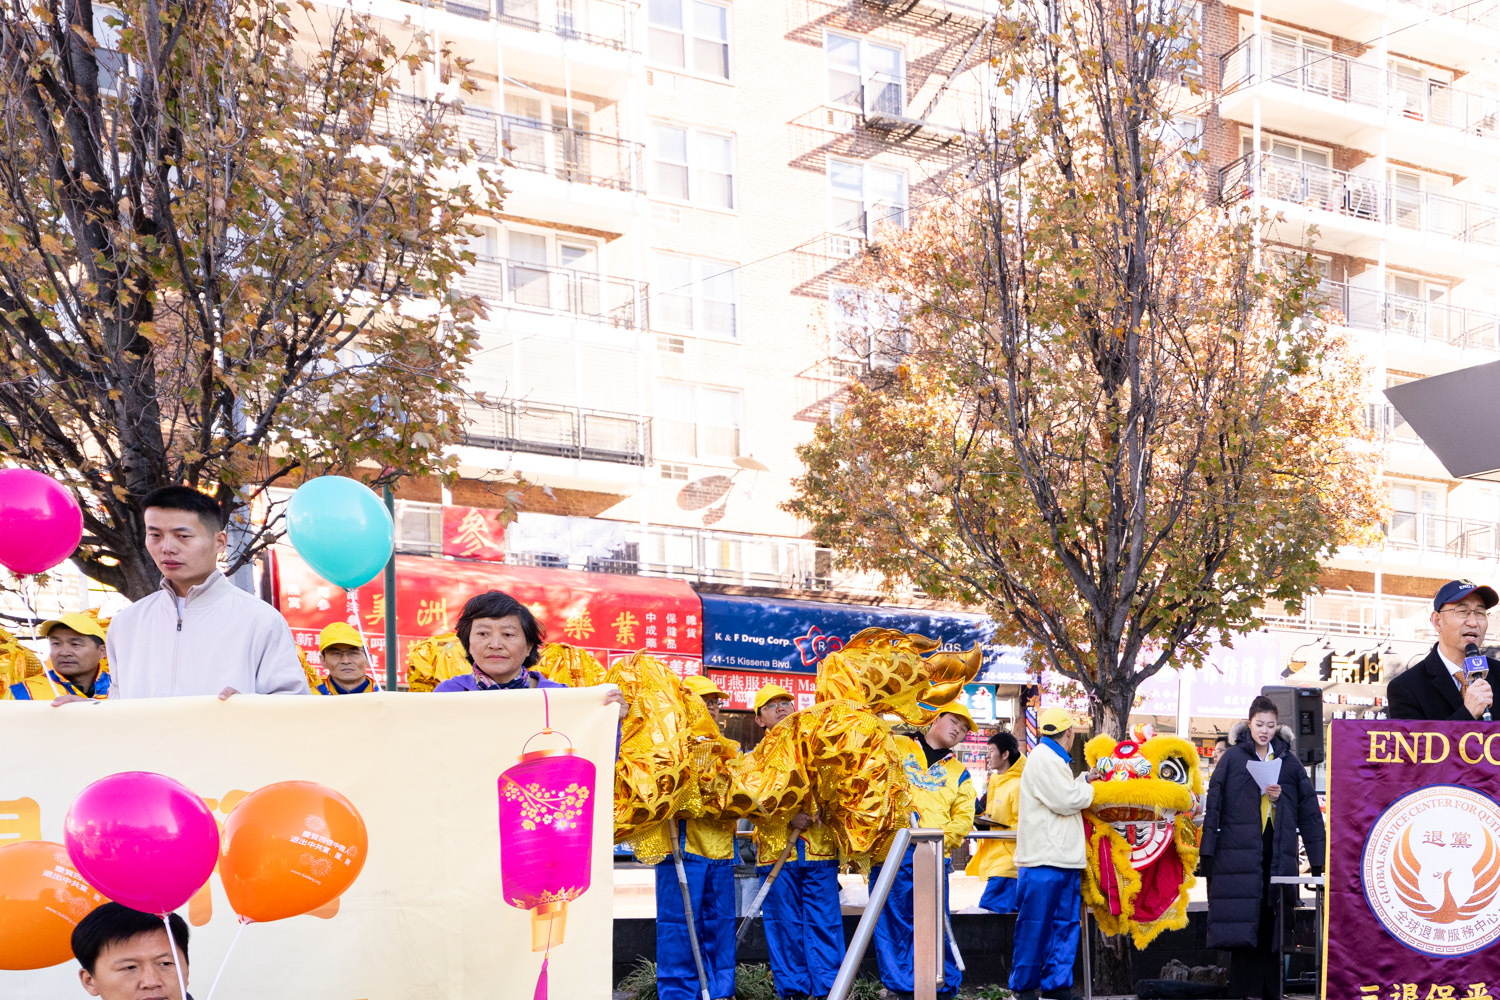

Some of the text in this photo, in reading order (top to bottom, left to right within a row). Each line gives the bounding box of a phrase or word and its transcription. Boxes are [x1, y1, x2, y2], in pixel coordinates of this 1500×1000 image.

[741, 635, 765, 647] Drug
[766, 637, 792, 647] Corp.
[711, 655, 792, 669] 41-15 Kissena Blvd.
[798, 679, 816, 691] Ma
[1366, 731, 1450, 764] END
[1408, 798, 1453, 817] CENTER
[1454, 799, 1478, 816] FOR
[1378, 813, 1410, 858] SERVICE
[1421, 830, 1473, 849] 退黨
[1376, 857, 1391, 904] GLOBAL
[1394, 910, 1499, 942] 全球退黨服務中心
